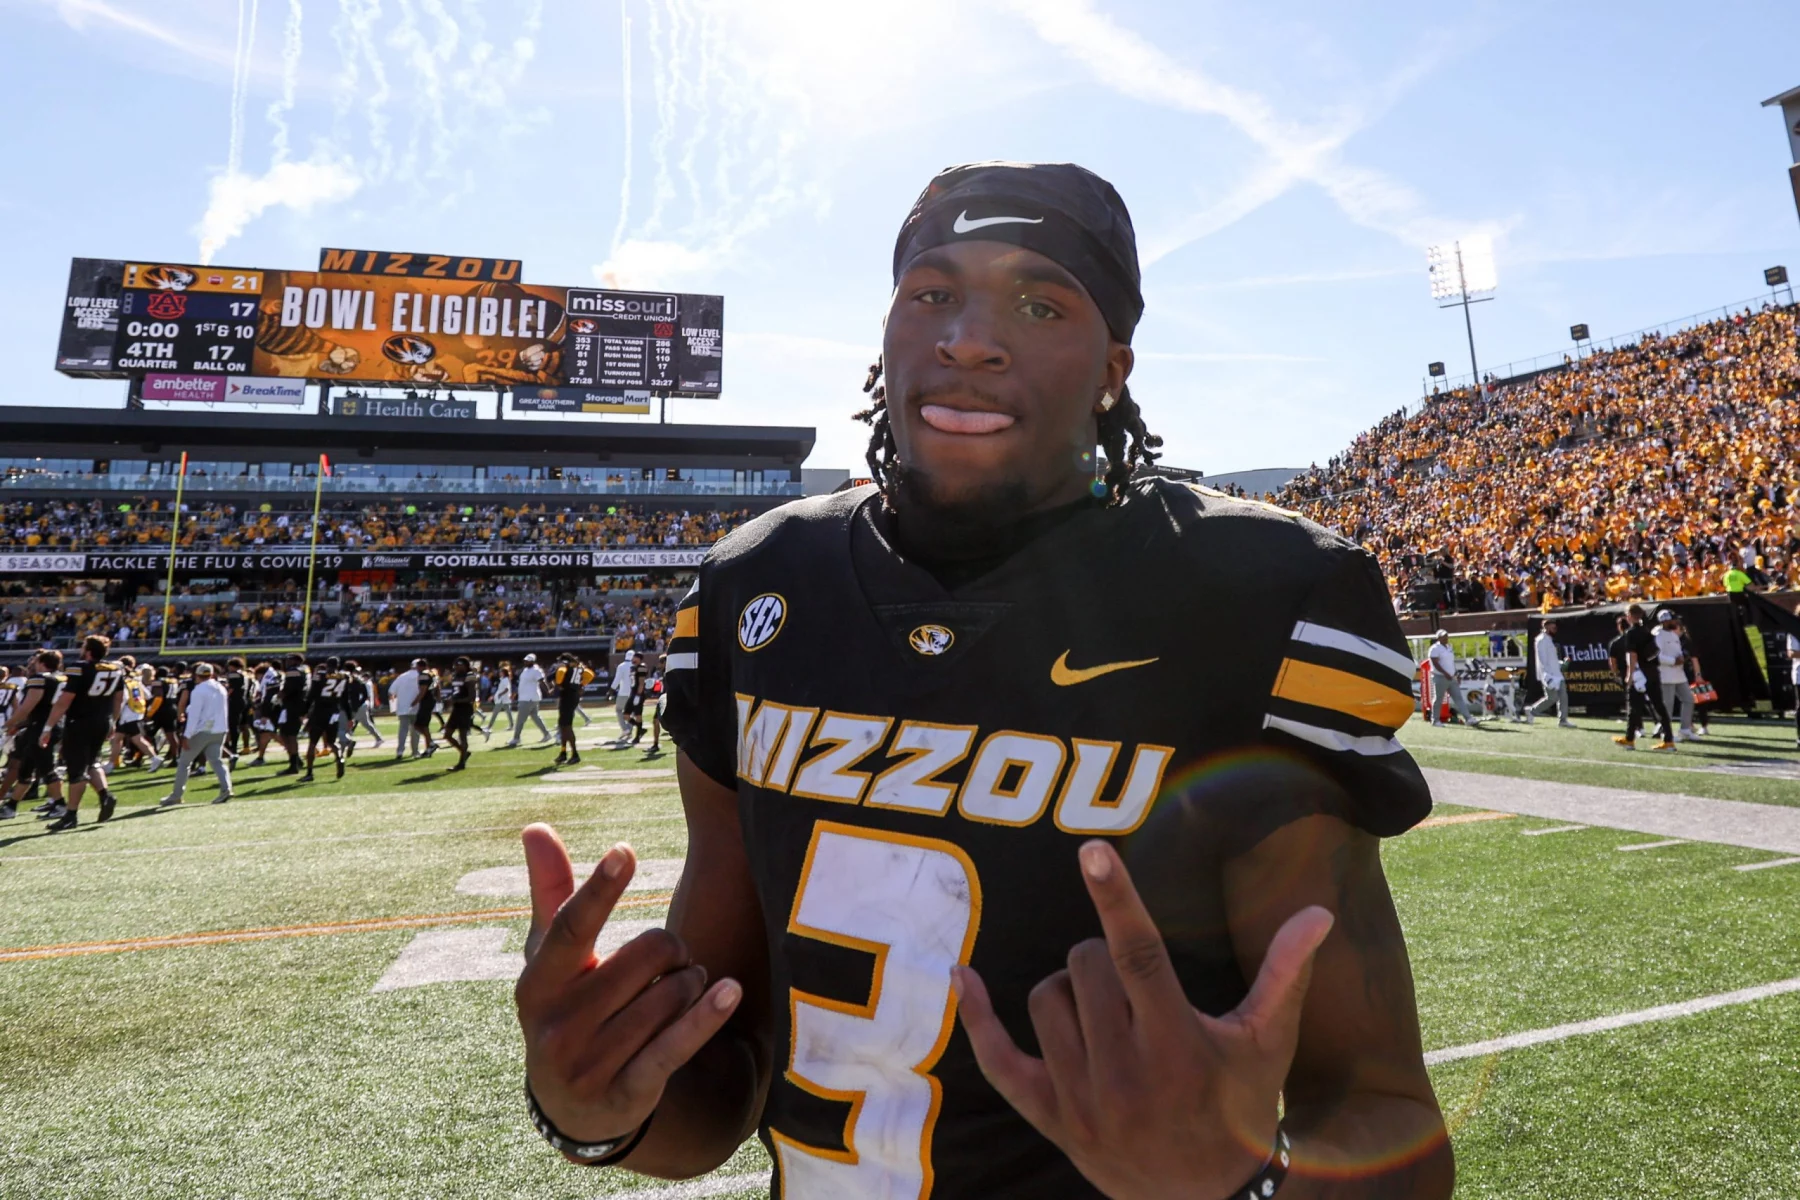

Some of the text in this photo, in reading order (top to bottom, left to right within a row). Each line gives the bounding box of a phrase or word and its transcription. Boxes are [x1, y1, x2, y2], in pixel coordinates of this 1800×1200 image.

[321, 249, 519, 281] MIZZOU
[231, 275, 258, 290] 21
[68, 296, 119, 309] LOW LEVEL
[229, 302, 255, 317] 17
[572, 294, 672, 314] missouri
[73, 307, 110, 318] ACCESS
[280, 286, 547, 339] BOWL ELIGIBLE!
[612, 313, 671, 322] CREDIT UNION
[126, 321, 180, 338] 0:00
[195, 323, 254, 339] 1ST & 10
[681, 327, 720, 338] LOW LEVEL
[686, 337, 715, 346] ACCESS
[126, 342, 174, 358] 4TH
[208, 345, 234, 360] 17
[118, 359, 177, 369] QUARTER
[193, 361, 246, 371] BALL ON
[153, 377, 217, 392] ambetter
[173, 391, 214, 399] HEALTH
[541, 398, 575, 406] SOUTHERN
[365, 401, 470, 418] Health Care
[7, 557, 83, 569] SEASON
[90, 556, 343, 569] TACKLE THE FLU & COVID-19
[424, 554, 589, 567] FOOTBALL SEASON IS
[594, 554, 704, 565] VACCINE SEASO
[740, 596, 784, 648] SEC
[1563, 643, 1608, 662] Health
[1563, 671, 1582, 680] EAM
[87, 670, 123, 697] 67
[320, 678, 347, 698] 24
[735, 692, 1176, 836] MIZZOU
[769, 819, 983, 1200] 3
